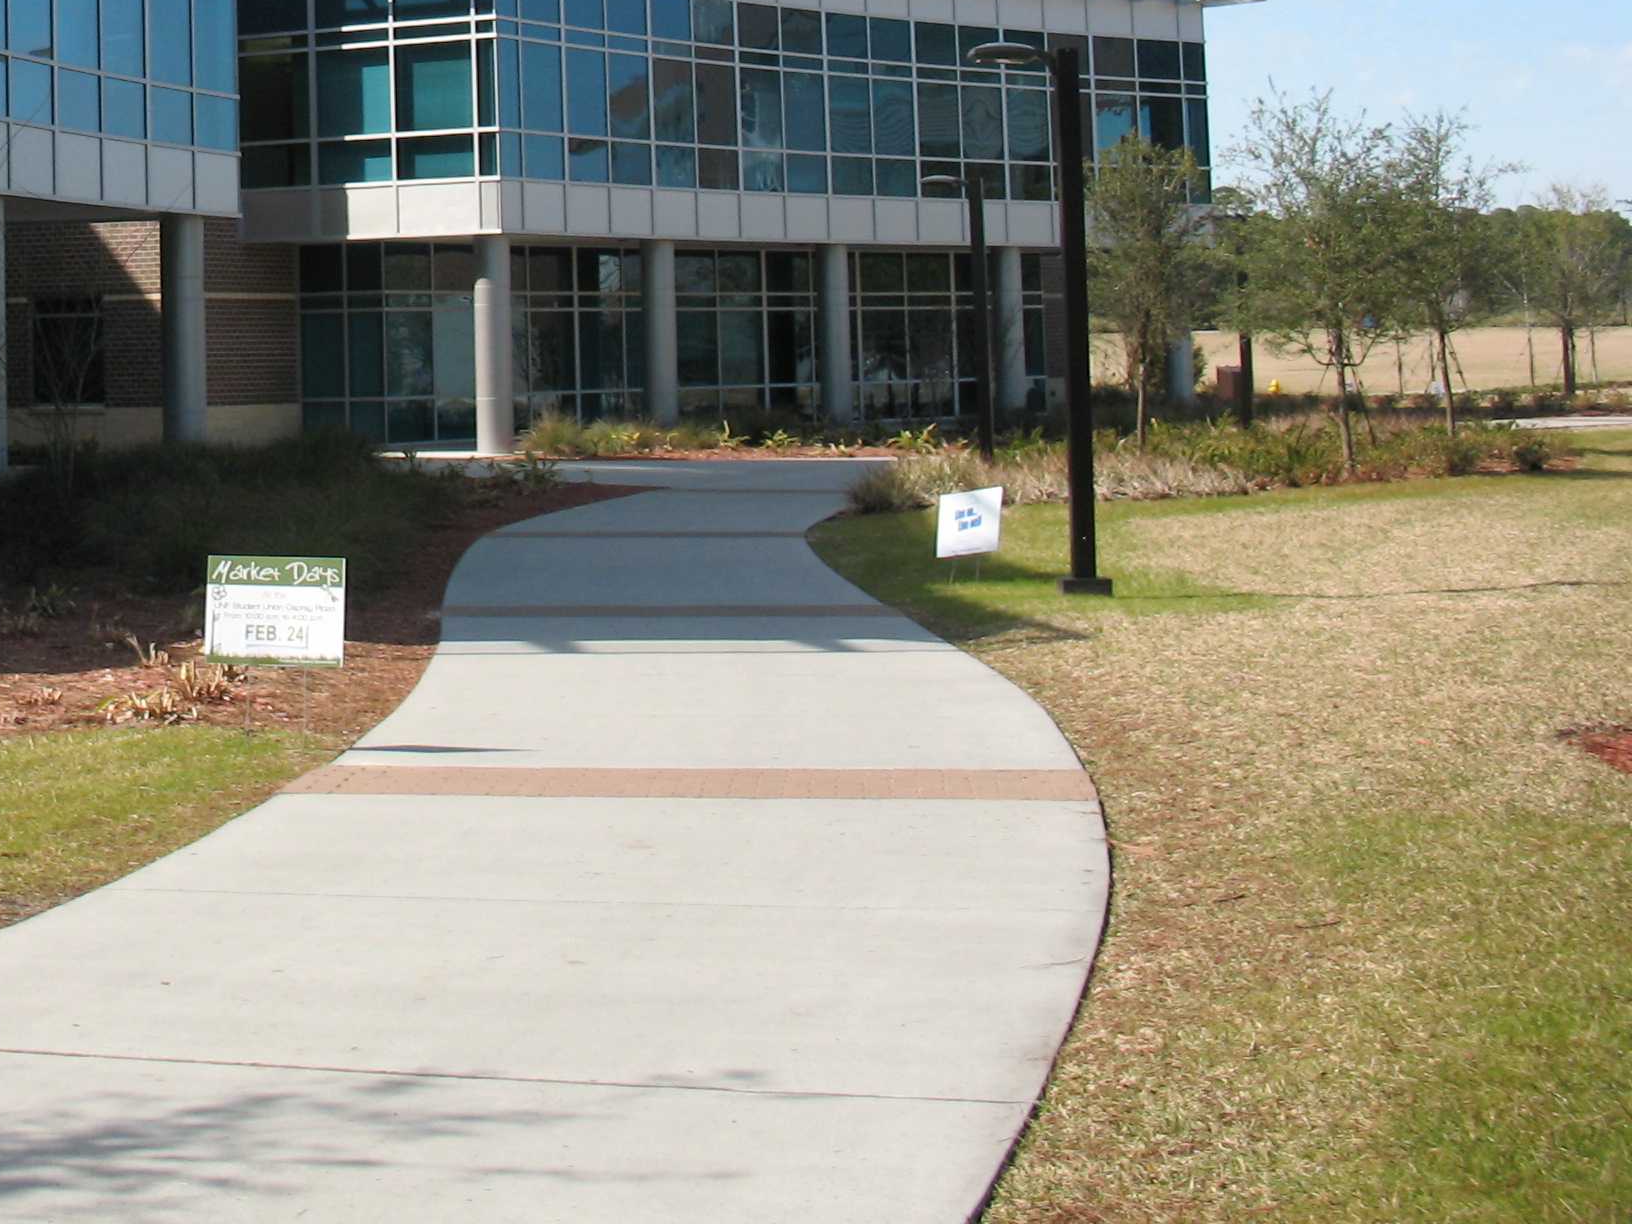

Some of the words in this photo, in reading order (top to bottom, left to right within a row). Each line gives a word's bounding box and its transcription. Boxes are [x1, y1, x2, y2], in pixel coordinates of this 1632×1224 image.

[212, 560, 282, 584] Market
[285, 561, 340, 586] Days
[244, 624, 282, 642] FEB.
[287, 625, 304, 642] 24
